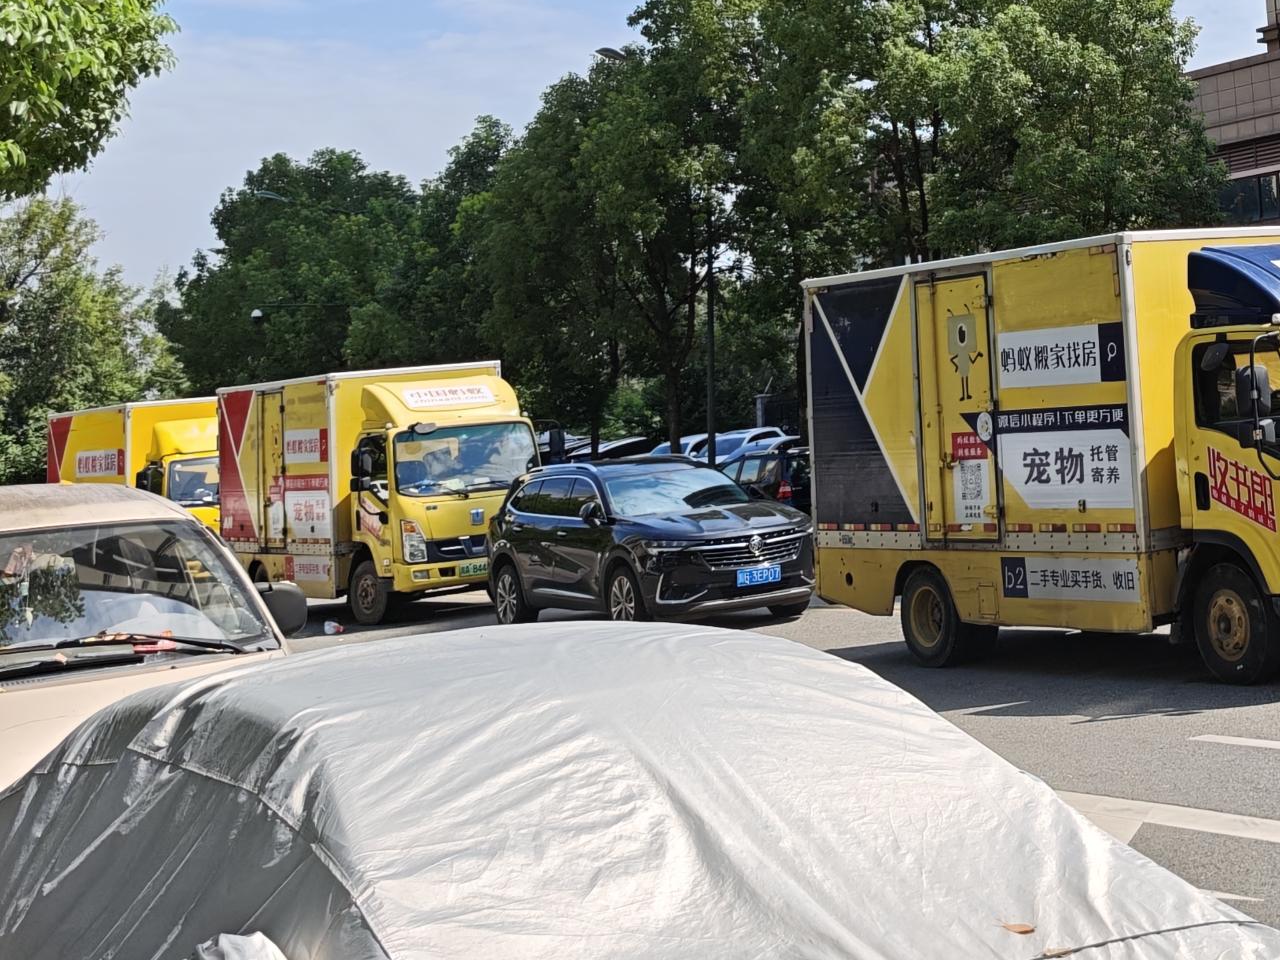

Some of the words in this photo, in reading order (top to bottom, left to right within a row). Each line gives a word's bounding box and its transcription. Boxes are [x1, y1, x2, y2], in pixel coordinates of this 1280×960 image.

[1000, 340, 1097, 373] 蚂蚁搬家找房
[1022, 447, 1085, 485] 宠物
[1090, 444, 1119, 463] 托管
[1091, 465, 1121, 484] 寄养
[1207, 445, 1276, 517] 收书郎
[1005, 565, 1024, 589] b2
